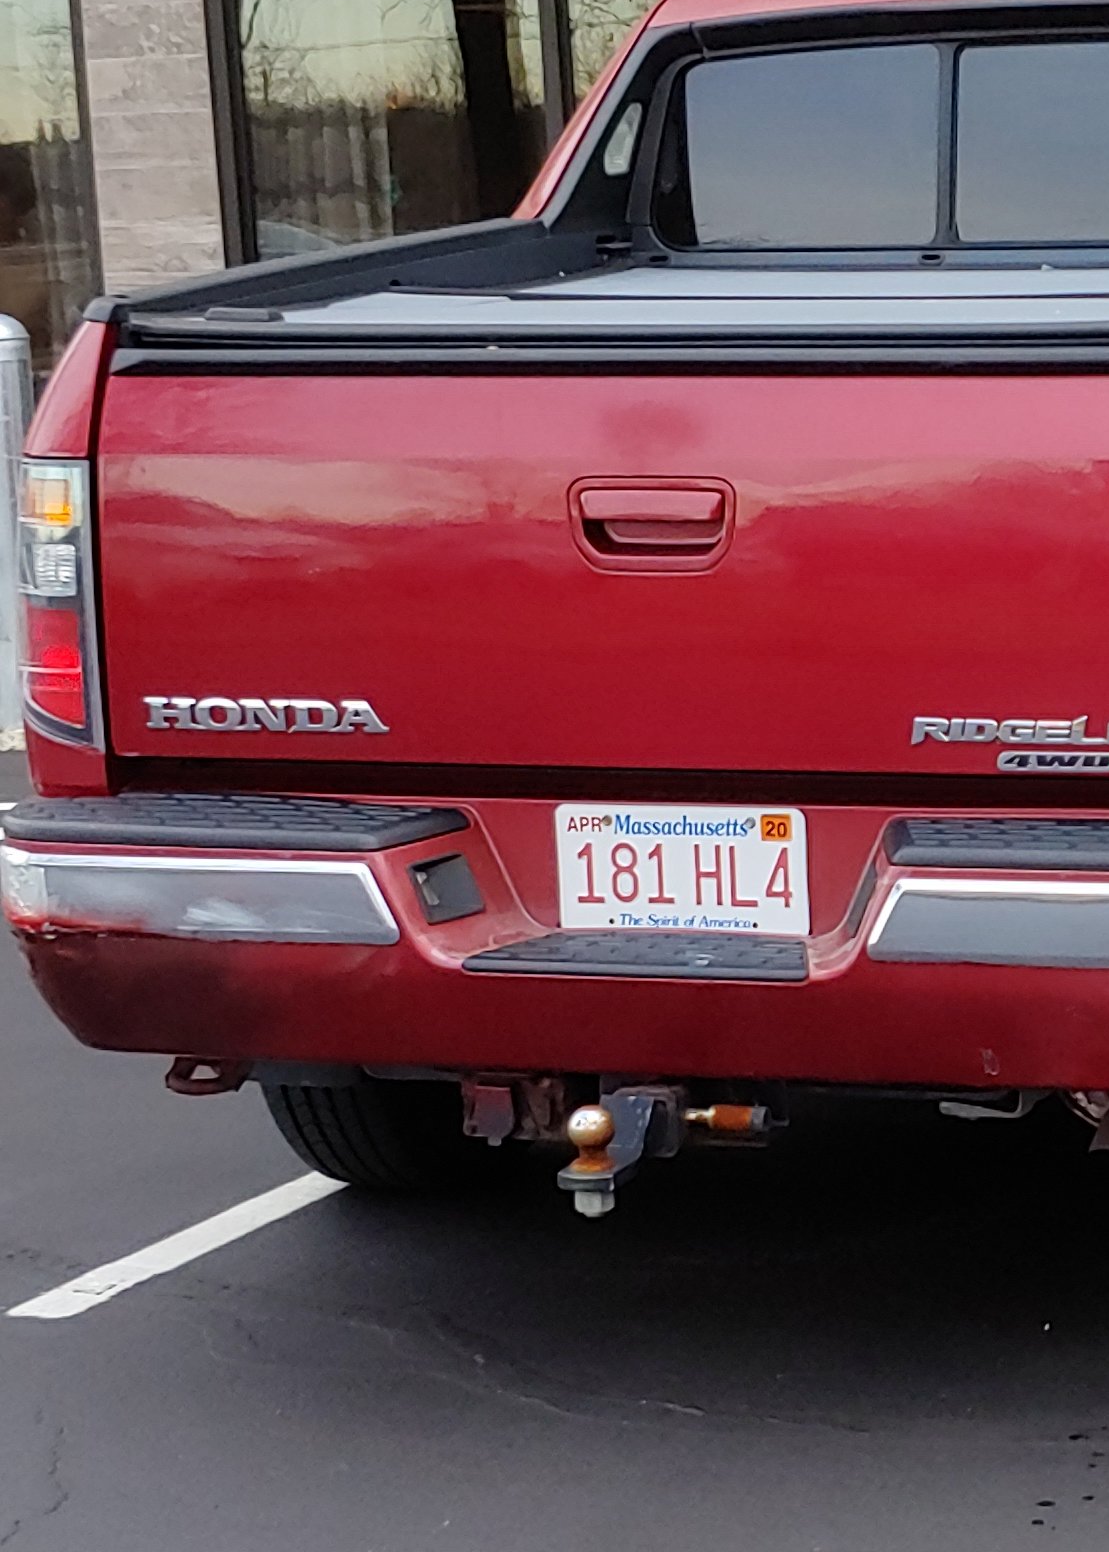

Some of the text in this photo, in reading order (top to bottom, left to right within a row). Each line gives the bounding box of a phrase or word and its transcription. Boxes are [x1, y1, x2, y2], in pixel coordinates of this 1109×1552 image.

[143, 696, 390, 734] HONDA
[567, 816, 602, 833] APR
[614, 814, 748, 836] Massachusetts
[765, 821, 788, 838] 20
[577, 842, 675, 904] 181
[620, 913, 751, 928] The Spirit of America
